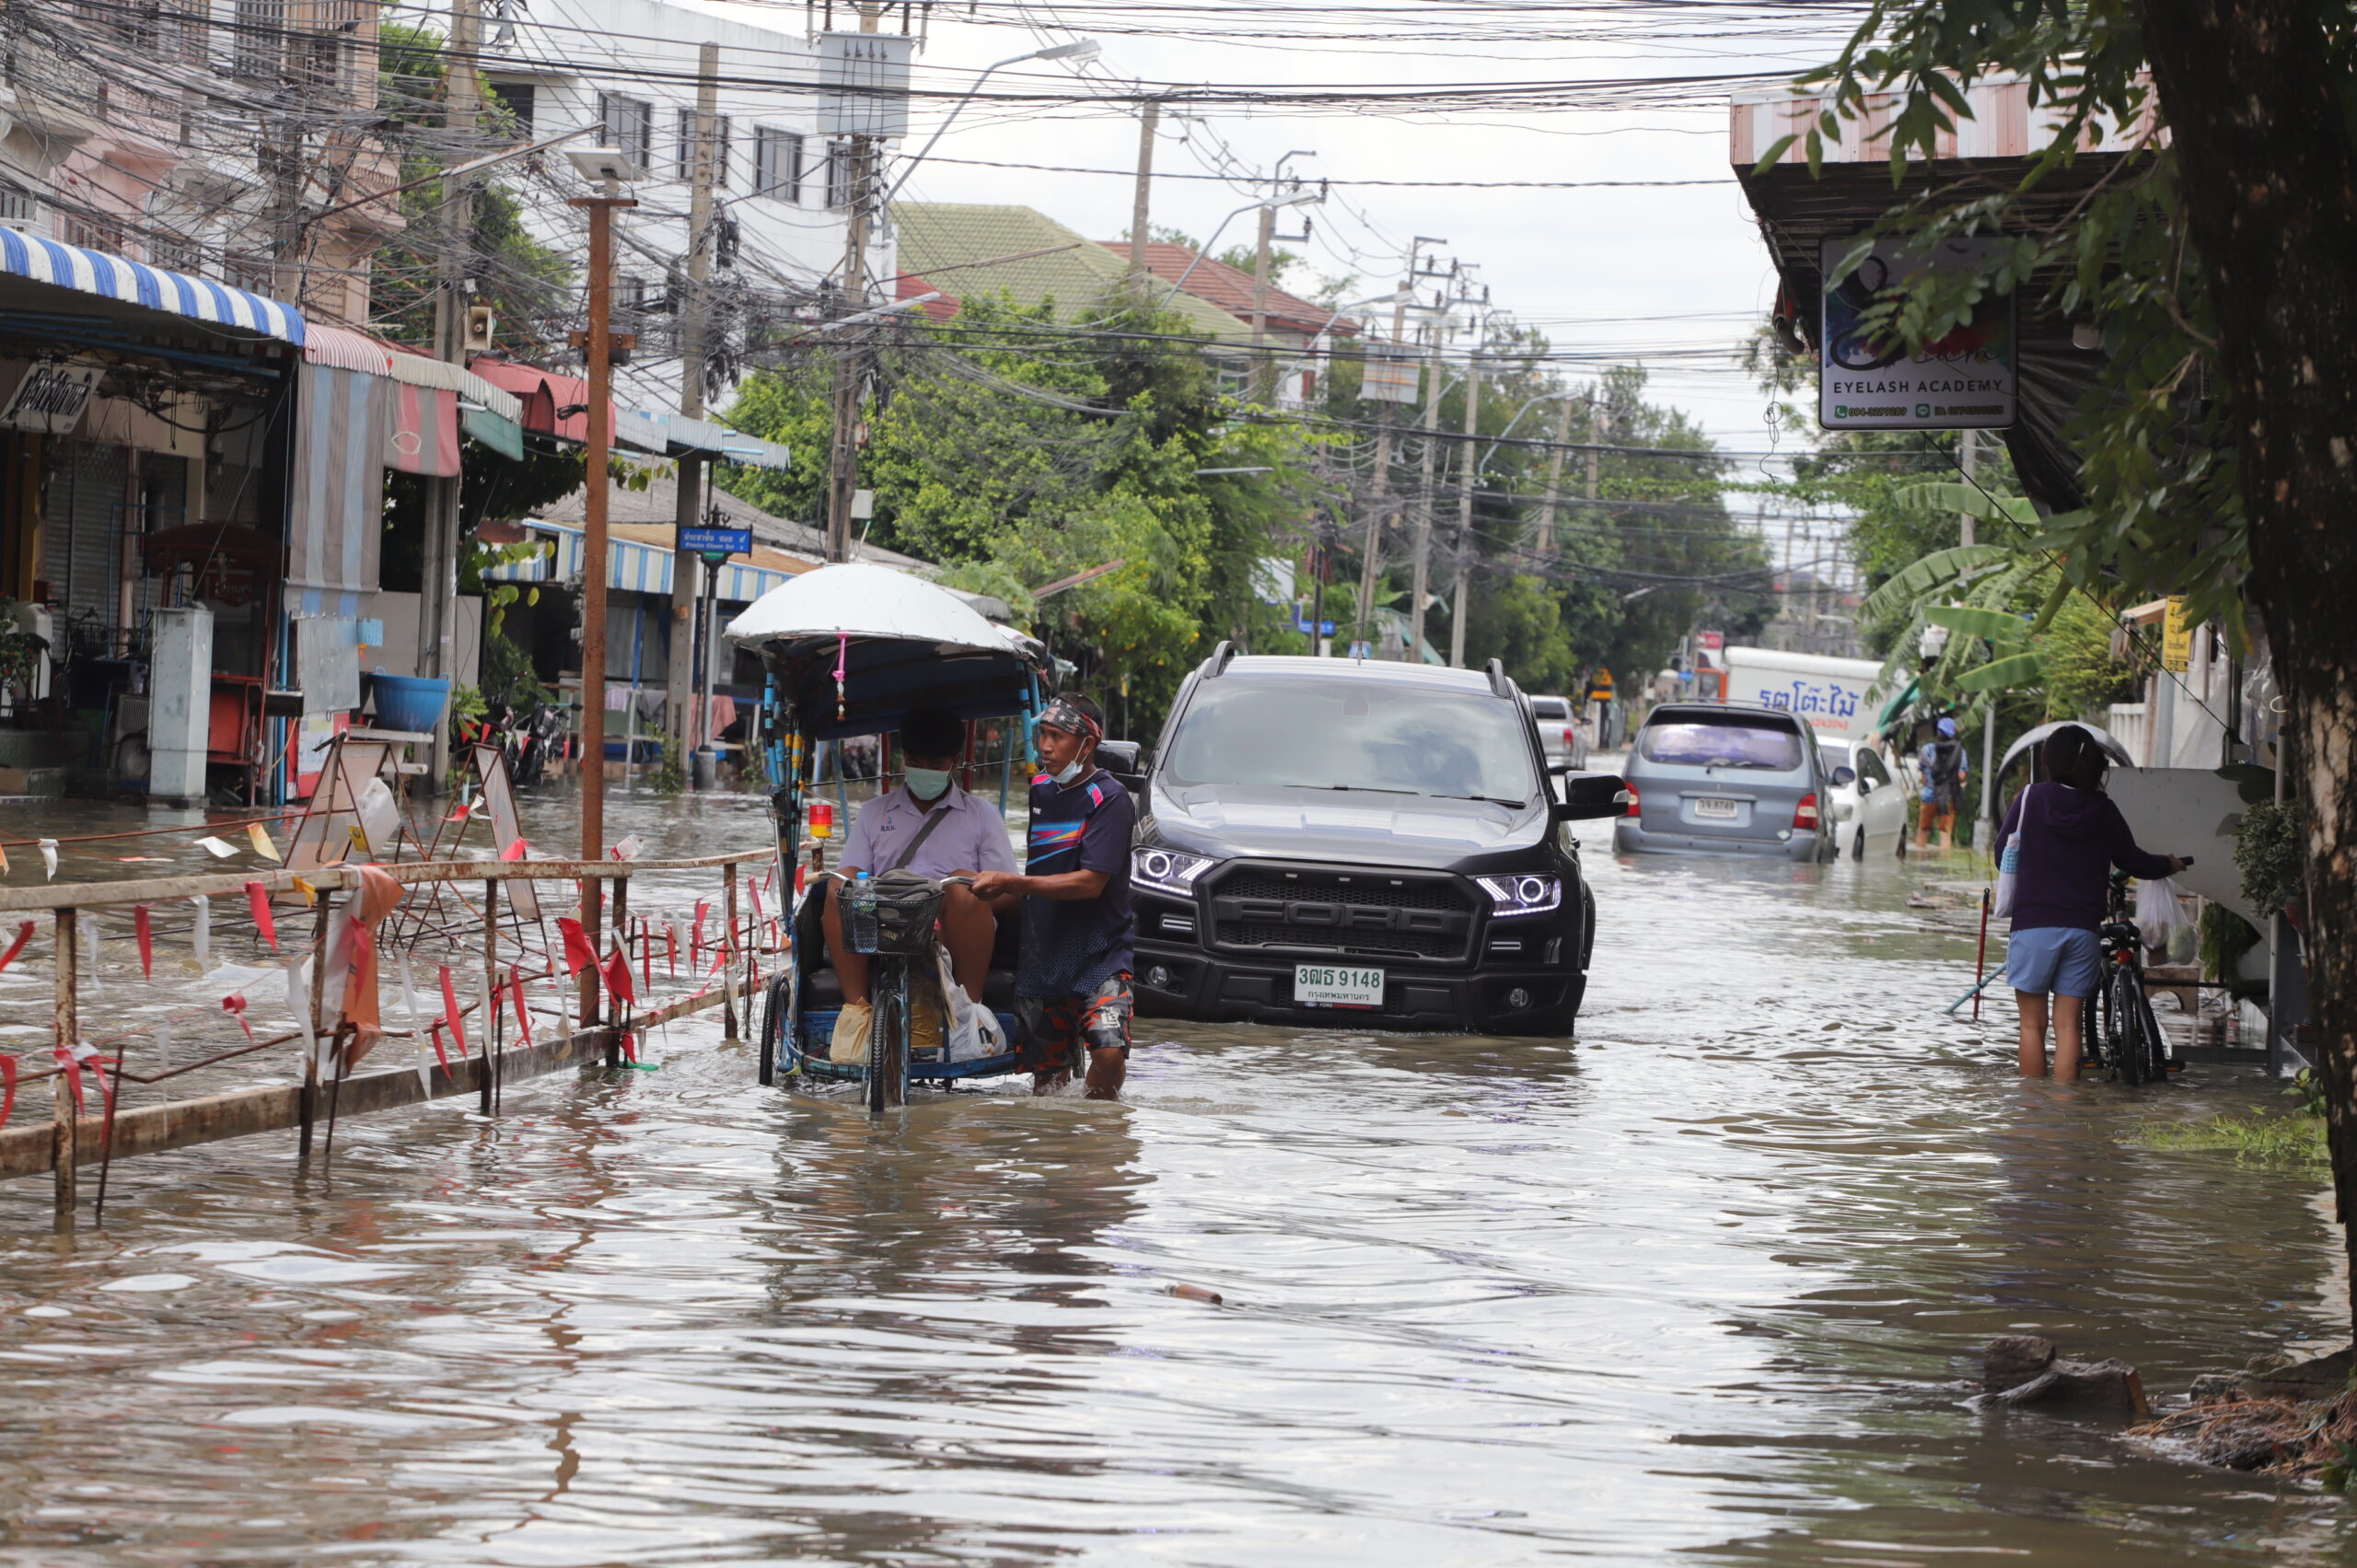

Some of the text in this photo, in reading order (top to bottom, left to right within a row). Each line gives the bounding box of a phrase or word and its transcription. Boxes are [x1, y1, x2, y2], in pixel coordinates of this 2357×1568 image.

[1833, 379, 2003, 393] EYELASH ACADEMY
[1234, 899, 1452, 934] FORD
[1339, 970, 1381, 988] 9148
[1307, 990, 1370, 1002] กรุงเทพมหานคร
